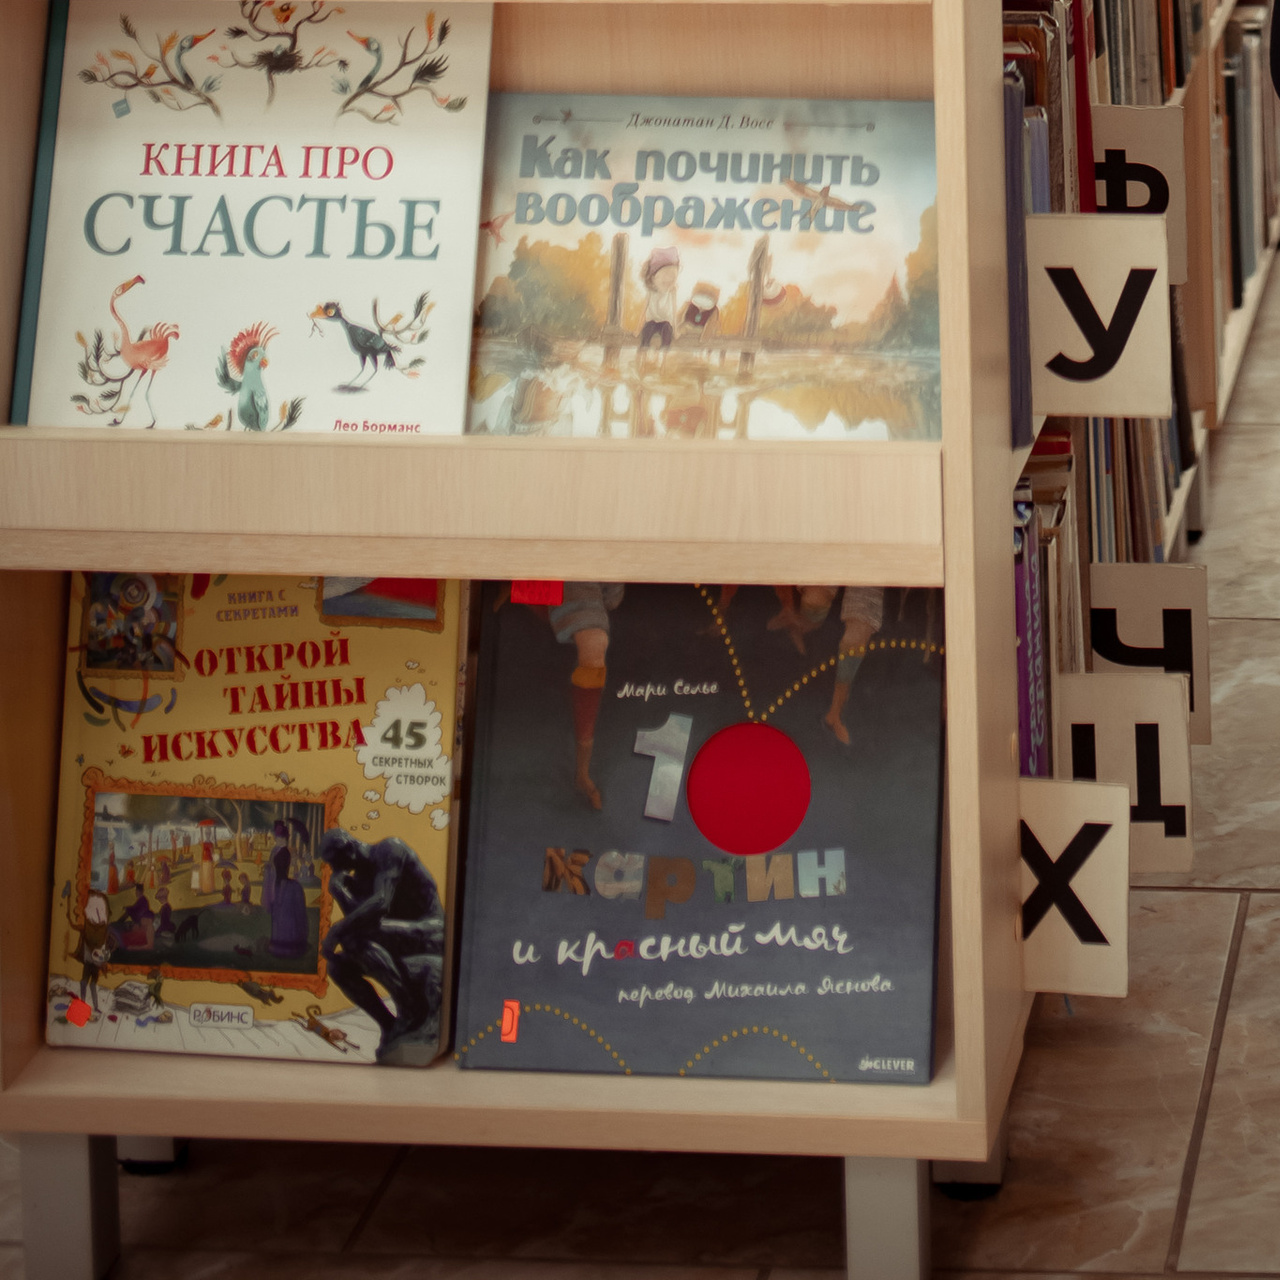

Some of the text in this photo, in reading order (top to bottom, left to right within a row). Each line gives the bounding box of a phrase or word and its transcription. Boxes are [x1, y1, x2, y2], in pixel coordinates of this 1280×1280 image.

[625, 112, 775, 131] Джонатан Д. Восс
[139, 142, 395, 181] КНИГА ПРО
[518, 134, 880, 186] Как починить
[83, 192, 441, 261] СЧАСТЬЕ
[514, 182, 877, 237] воображение
[1044, 267, 1157, 382] У
[332, 419, 422, 434] Лео Борманс
[215, 605, 299, 622] СЕКРЕТАМИ
[226, 589, 287, 605] КНИГА С
[193, 630, 350, 677] ОТКРОЙ
[1090, 607, 1195, 712] Ч
[222, 673, 368, 715] ТАЙНЫ
[616, 679, 719, 702] Мари Селье
[140, 718, 369, 764] ИСКУССТВА
[379, 718, 429, 751] 45
[371, 755, 434, 770] СЕКРЕТНЫХ
[395, 773, 447, 787] СТВОРОК
[541, 846, 848, 920] картин
[1020, 819, 1113, 946] Х
[511, 937, 541, 966] и
[556, 921, 749, 976] красный
[617, 974, 895, 1008] перевод Михаила Яснова
[193, 1008, 249, 1025] РОБИНС
[873, 1059, 914, 1071] CLEVER
